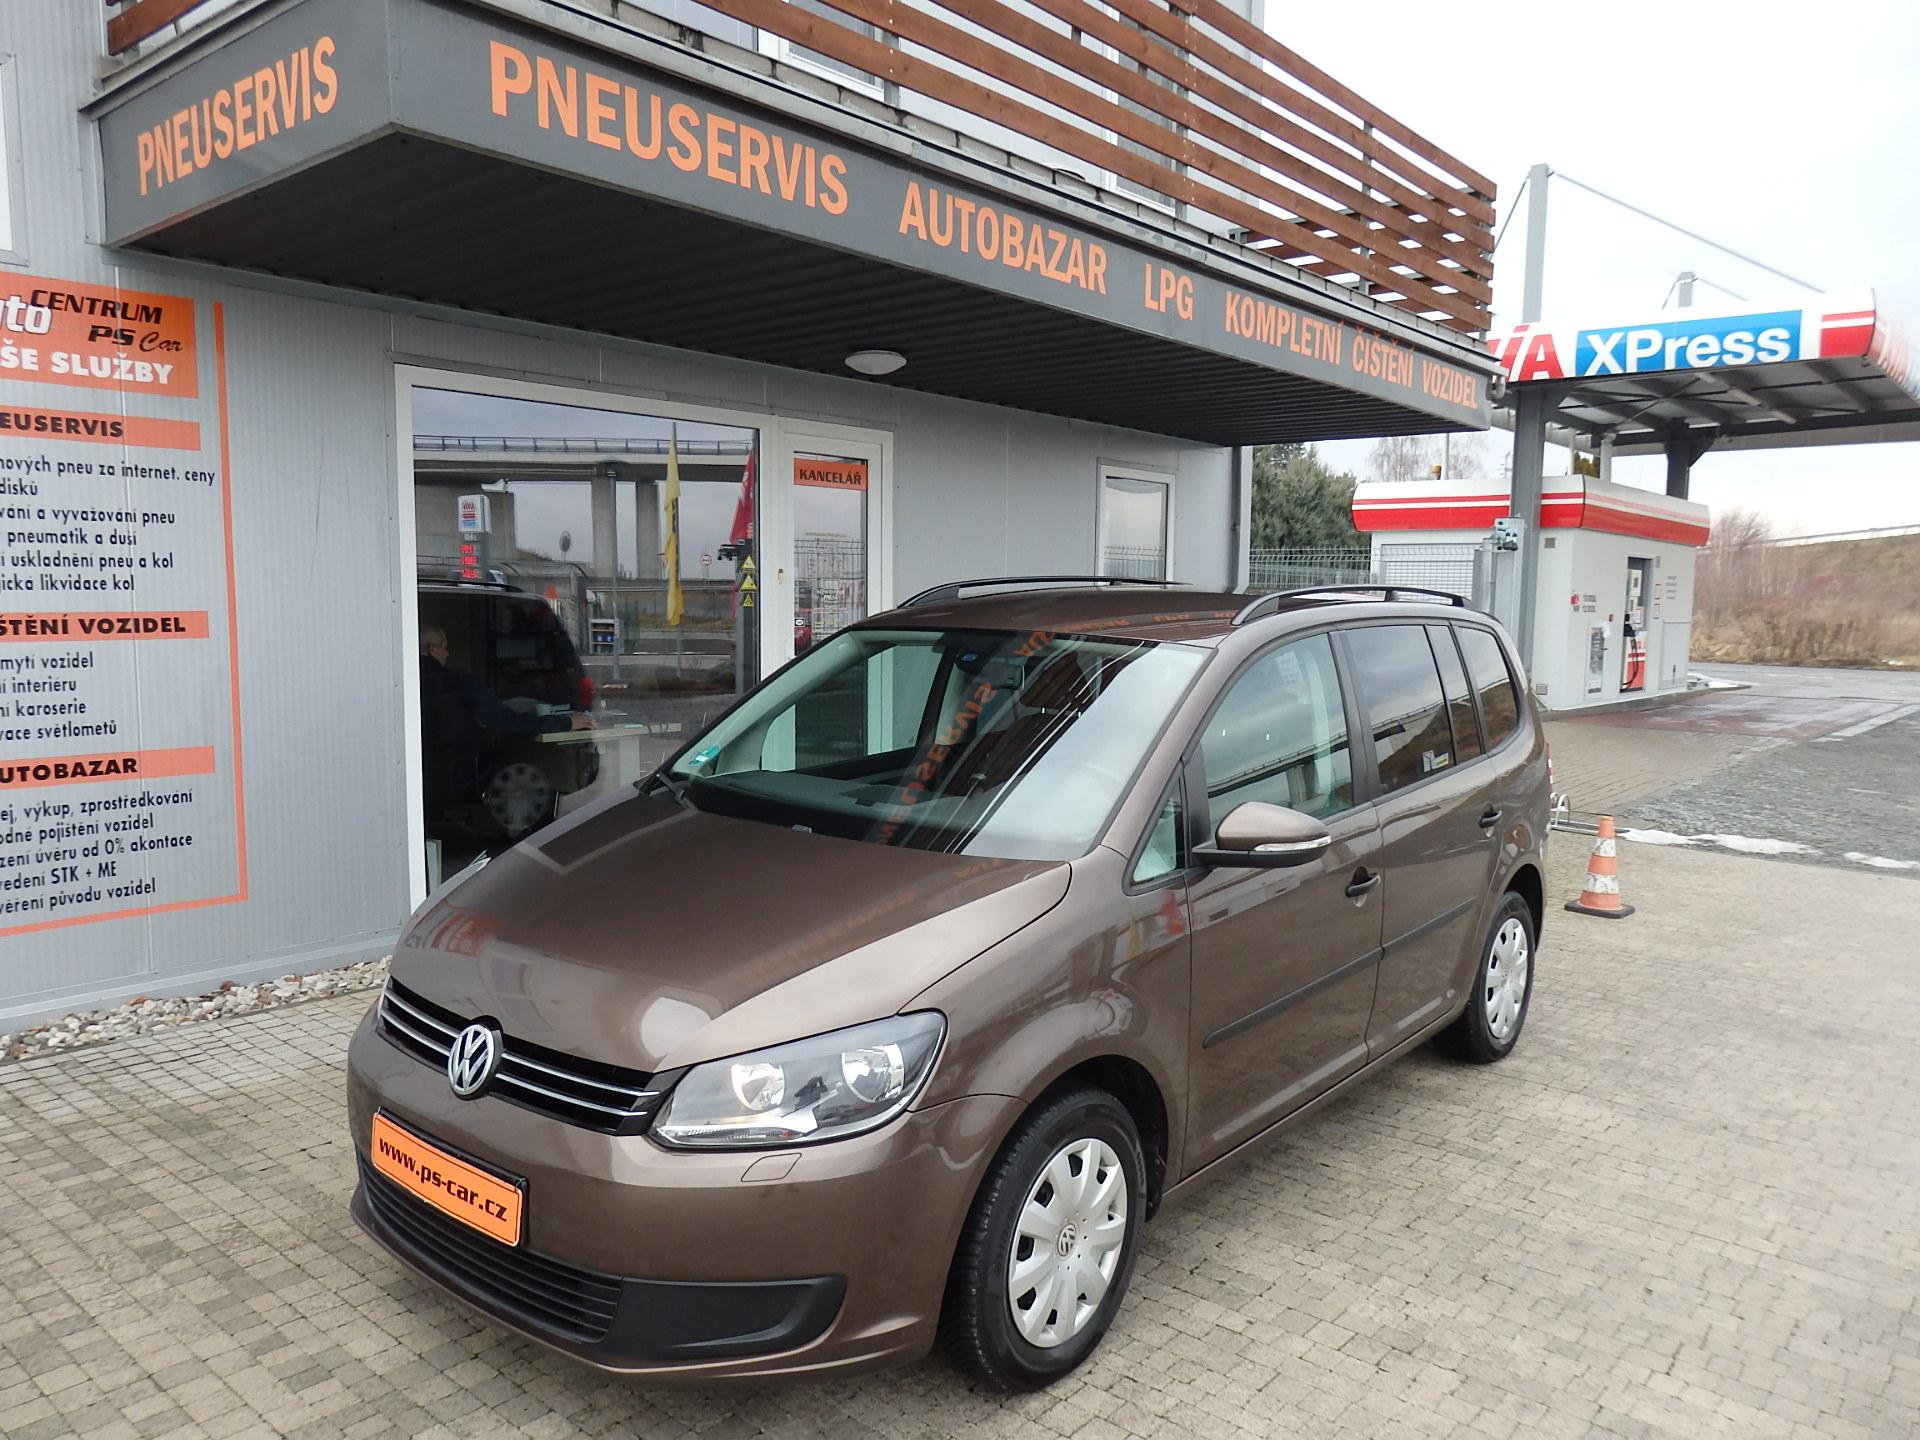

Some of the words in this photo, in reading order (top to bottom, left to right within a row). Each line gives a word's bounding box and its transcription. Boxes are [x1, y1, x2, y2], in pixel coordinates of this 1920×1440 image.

[137, 36, 338, 198] PNEUSERVIS
[489, 39, 848, 216] PNEUSERVIS
[899, 181, 1108, 295] AUTOBAZAR
[1144, 263, 1194, 321] LPG
[1225, 290, 1345, 365] KOMPLETNÍ
[1352, 324, 1415, 388] ČIŠTĚNÍ
[1422, 360, 1478, 409] VOZIDEL
[31, 289, 163, 325] CENTRUM
[88, 325, 137, 346] PS
[139, 331, 184, 353] Car
[1582, 327, 1792, 376] XPress
[51, 352, 174, 385] SLUŽBY
[57, 461, 93, 477] pneu
[99, 464, 115, 476] za
[121, 461, 180, 481] internet.
[184, 469, 215, 486] ceny
[37, 508, 46, 519] a
[52, 506, 137, 525] vyvažování
[142, 511, 175, 527] pneu
[7, 528, 88, 547] pneumatik
[95, 533, 103, 545] a
[11, 550, 94, 568] uskladnění
[99, 555, 134, 572] pneu
[138, 557, 147, 568] a
[152, 552, 173, 568] kol
[40, 574, 107, 591] likvidace
[113, 574, 135, 591] kol
[78, 617, 186, 634] VOZIDEL
[41, 651, 94, 669] vozidel
[12, 676, 77, 694] interiéru
[16, 698, 86, 717] karoserie
[37, 720, 117, 739] světlometů
[24, 801, 74, 823] výkup,
[80, 788, 193, 817] zprostředkování
[39, 820, 99, 845] pojištění
[104, 813, 154, 832] vozidel
[35, 845, 77, 864] úvěru
[82, 840, 99, 857] od
[104, 837, 125, 855] 0%
[130, 834, 193, 852] akontace
[51, 866, 79, 885] STK
[85, 867, 92, 878] +
[97, 860, 117, 879] ME
[49, 886, 102, 911] původu
[106, 877, 156, 898] vozidel
[378, 1137, 508, 1222] www.ps-car.cz
